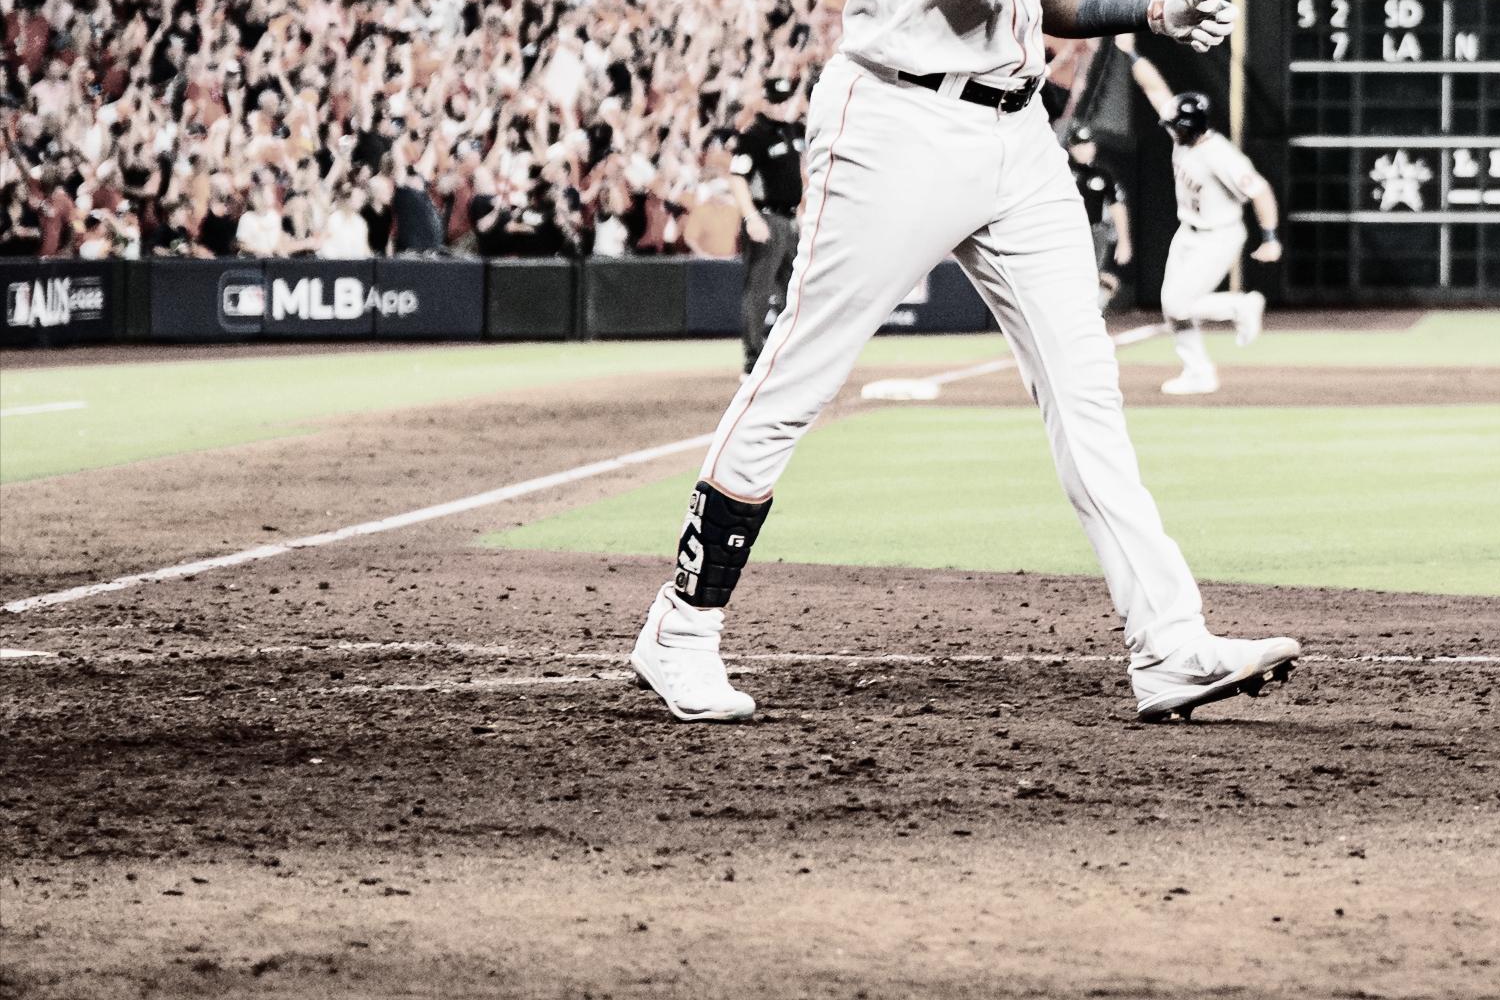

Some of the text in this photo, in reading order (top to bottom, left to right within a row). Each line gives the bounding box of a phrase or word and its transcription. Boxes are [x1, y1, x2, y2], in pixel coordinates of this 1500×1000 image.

[1382, 31, 1422, 62] LA
[272, 277, 419, 320] MLB App
